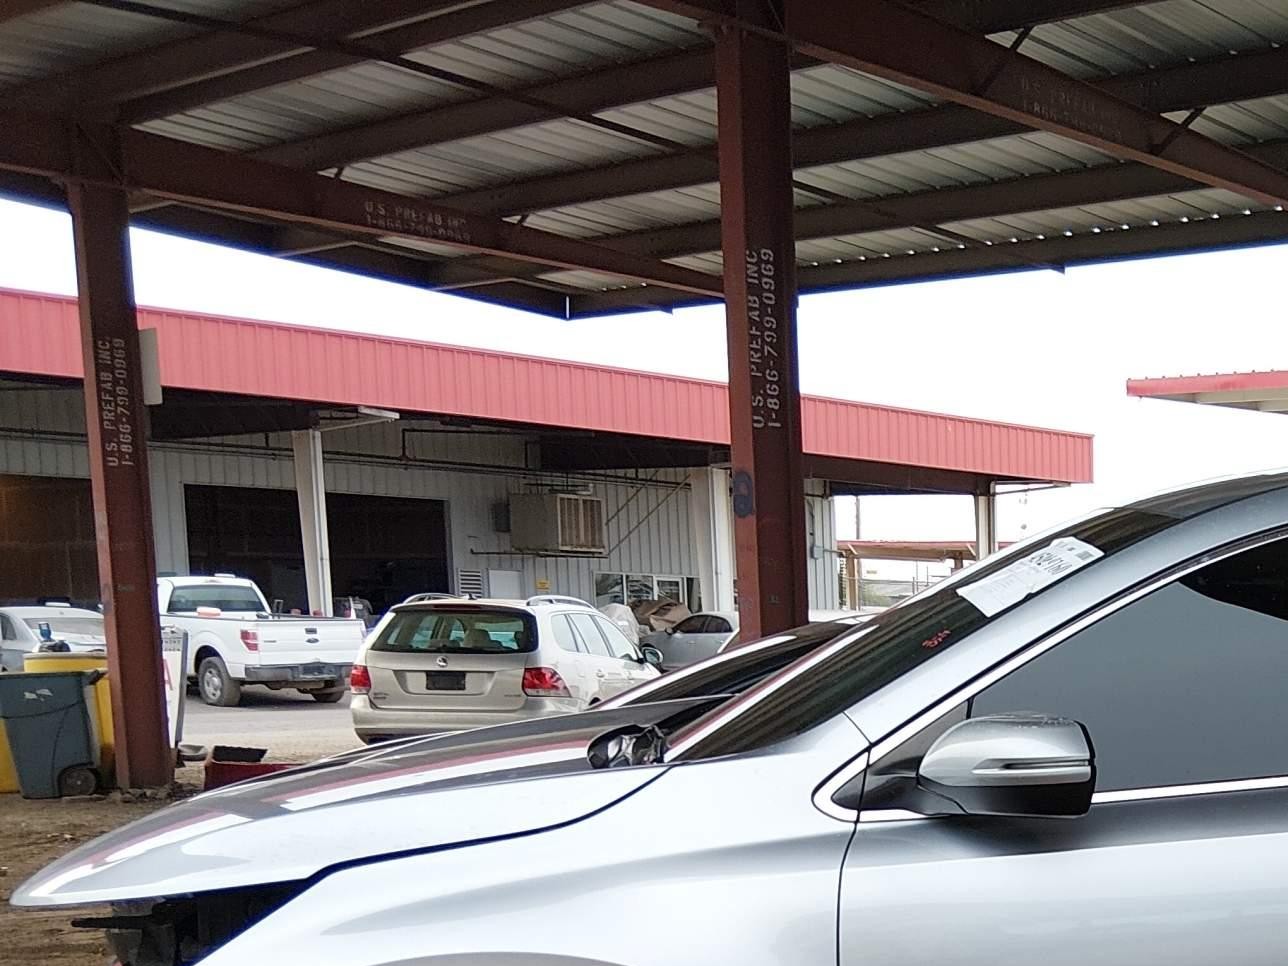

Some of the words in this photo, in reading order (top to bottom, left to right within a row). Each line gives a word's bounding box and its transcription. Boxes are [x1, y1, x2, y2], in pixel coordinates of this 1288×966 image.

[748, 295, 763, 377] PREFAB
[761, 248, 781, 428] 1-866-799-0969
[100, 372, 116, 430] PREFAB
[112, 338, 135, 466] 1-866-799-0969
[751, 390, 766, 428] U.S.
[105, 439, 119, 467] U.S.
